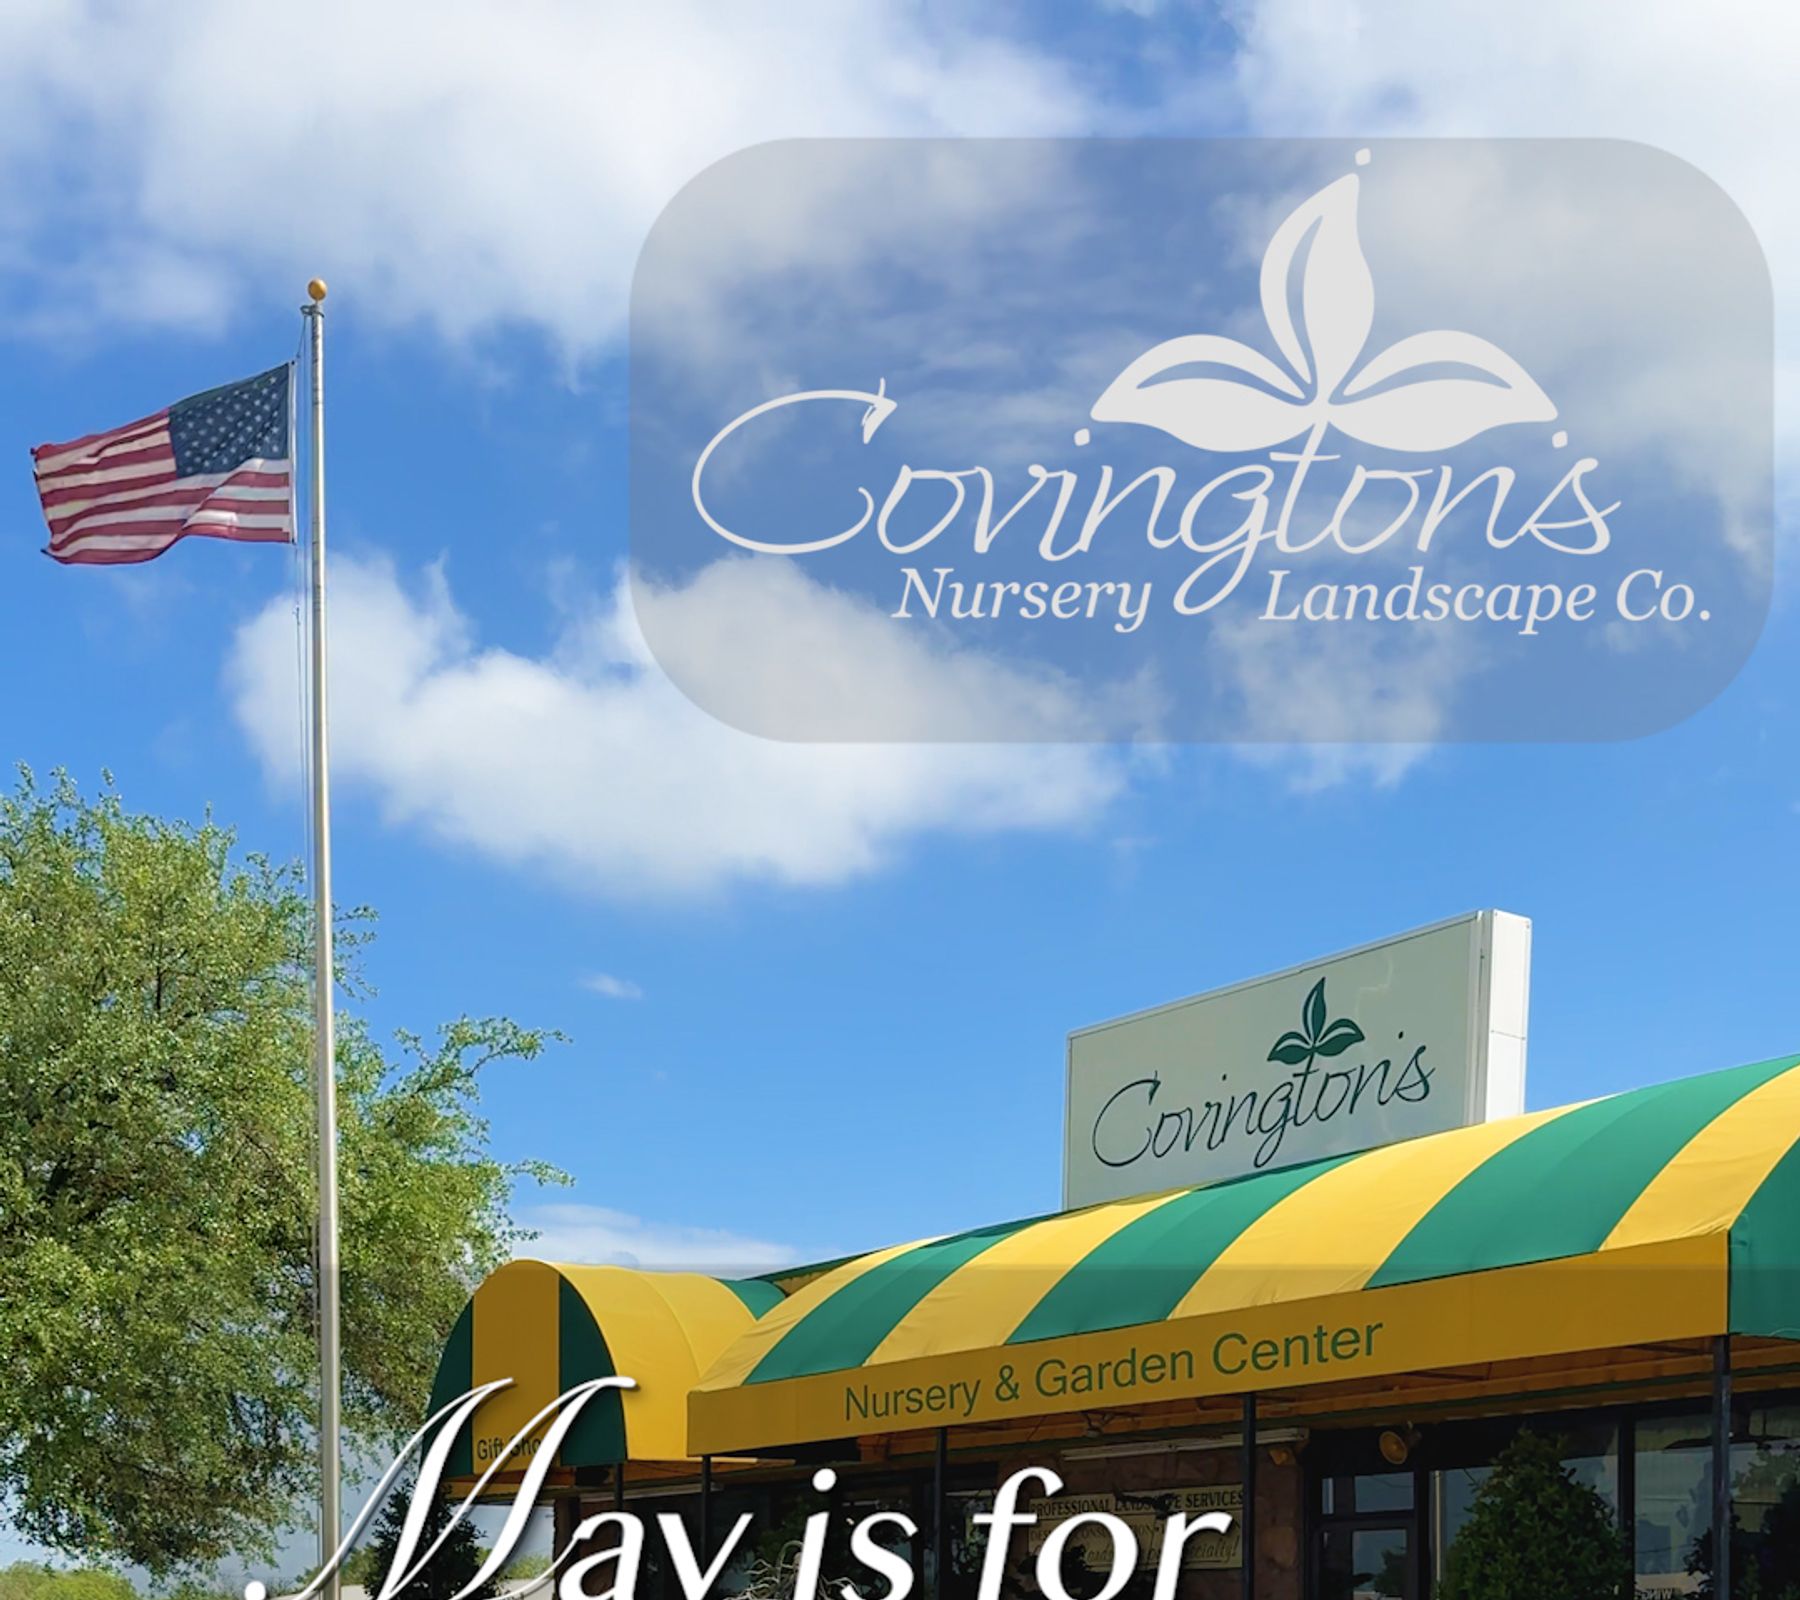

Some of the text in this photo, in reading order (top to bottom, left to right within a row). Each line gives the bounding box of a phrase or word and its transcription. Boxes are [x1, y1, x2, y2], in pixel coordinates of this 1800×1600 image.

[846, 1322, 1384, 1421] Nursery & Garden Center
[477, 1436, 505, 1460] Gift
[1030, 1497, 1111, 1517] PROFESSIONAL
[1184, 1489, 1244, 1509] SERVICES
